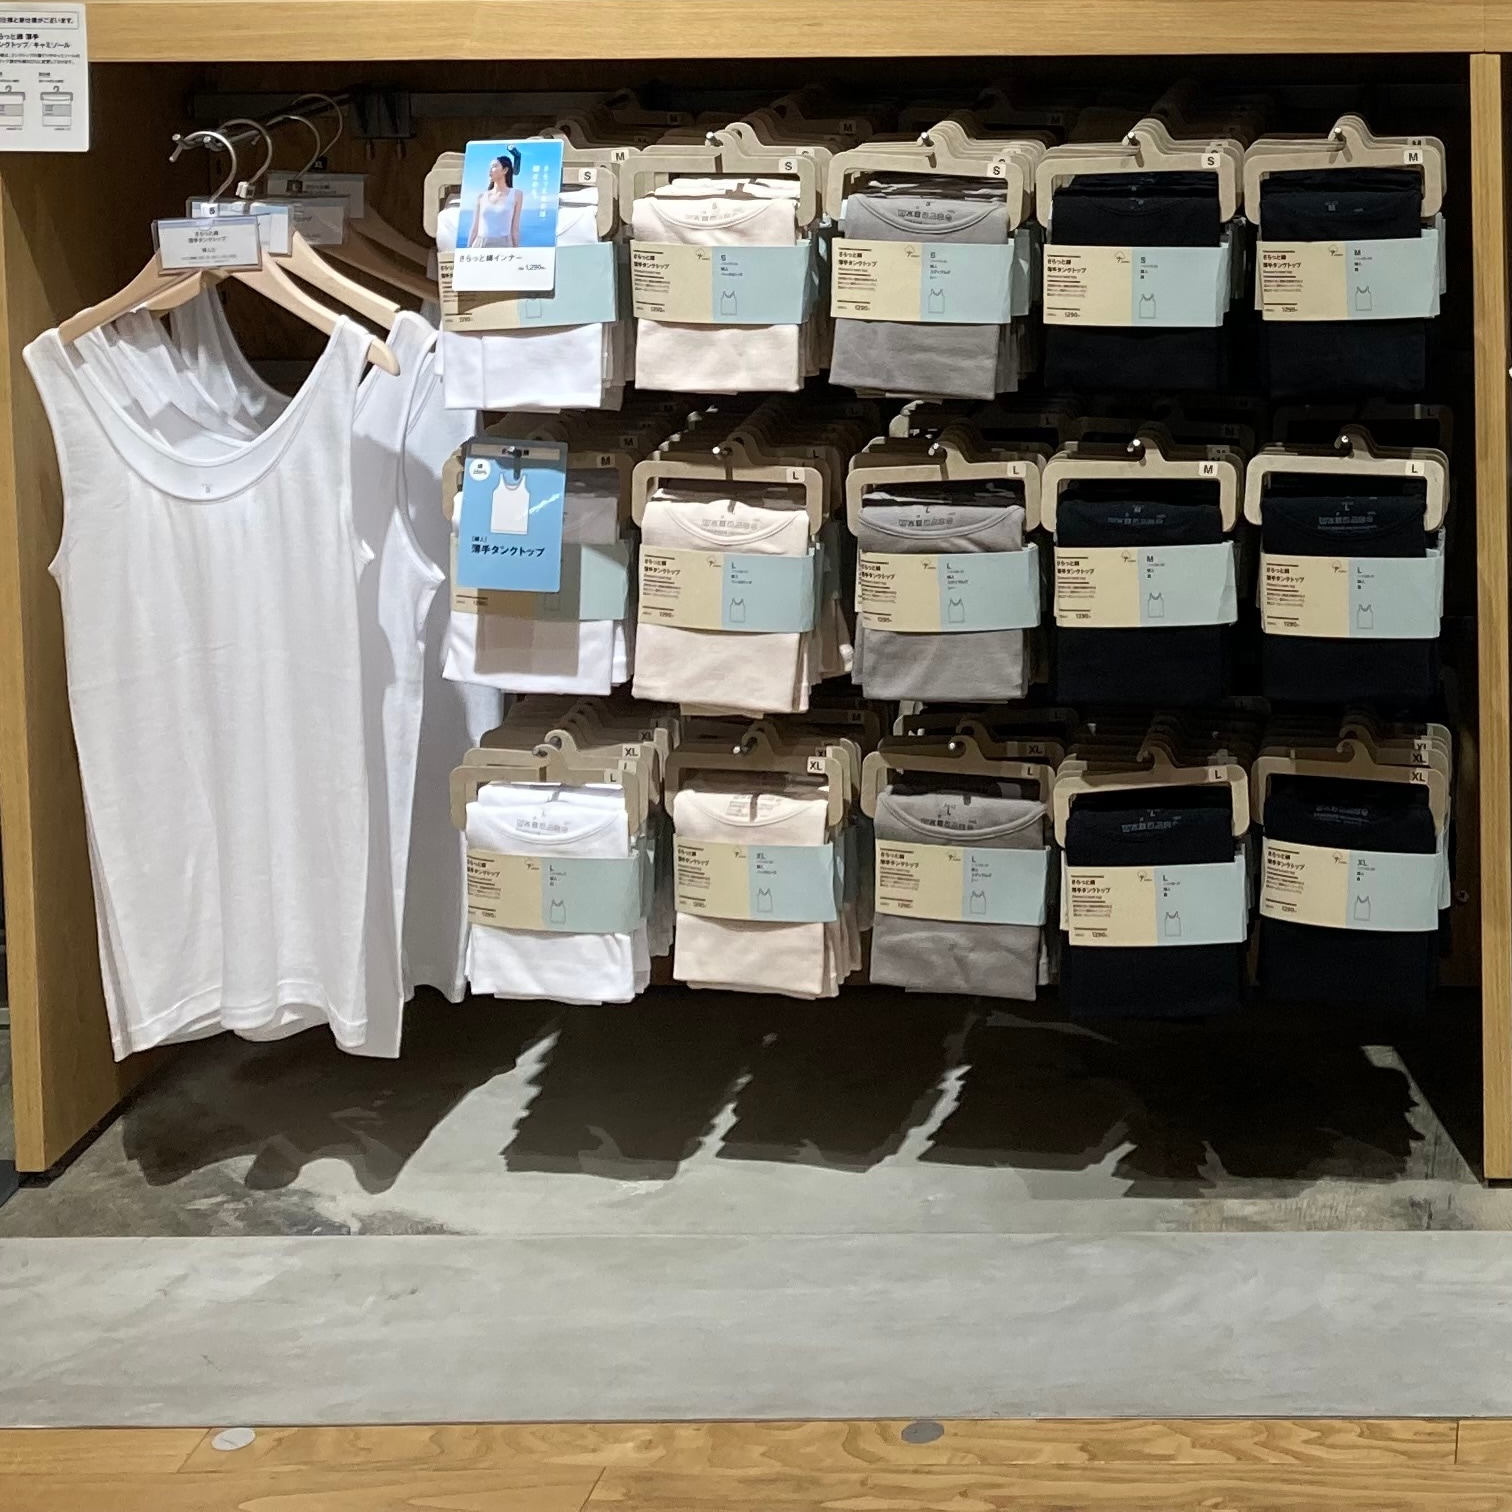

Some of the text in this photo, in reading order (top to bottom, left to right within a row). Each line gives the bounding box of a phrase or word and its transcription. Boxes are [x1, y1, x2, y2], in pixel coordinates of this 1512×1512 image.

[615, 152, 625, 161] M
[1207, 156, 1215, 166] S
[1408, 152, 1419, 161] M
[784, 161, 792, 171] S
[992, 166, 1001, 175] S
[584, 171, 592, 181] S
[600, 456, 611, 465] M
[1012, 466, 1019, 474] L
[1203, 464, 1213, 473] M
[1411, 464, 1418, 474] L
[792, 471, 799, 480] L
[471, 544, 545, 557] 薄手タンクトップ
[624, 747, 638, 757] XL
[1028, 746, 1042, 754] XL
[1412, 754, 1426, 763] XL
[810, 761, 823, 770] XL
[1027, 767, 1033, 775] L
[1214, 770, 1222, 779] L
[609, 773, 616, 782] L
[1412, 772, 1425, 782] XL
